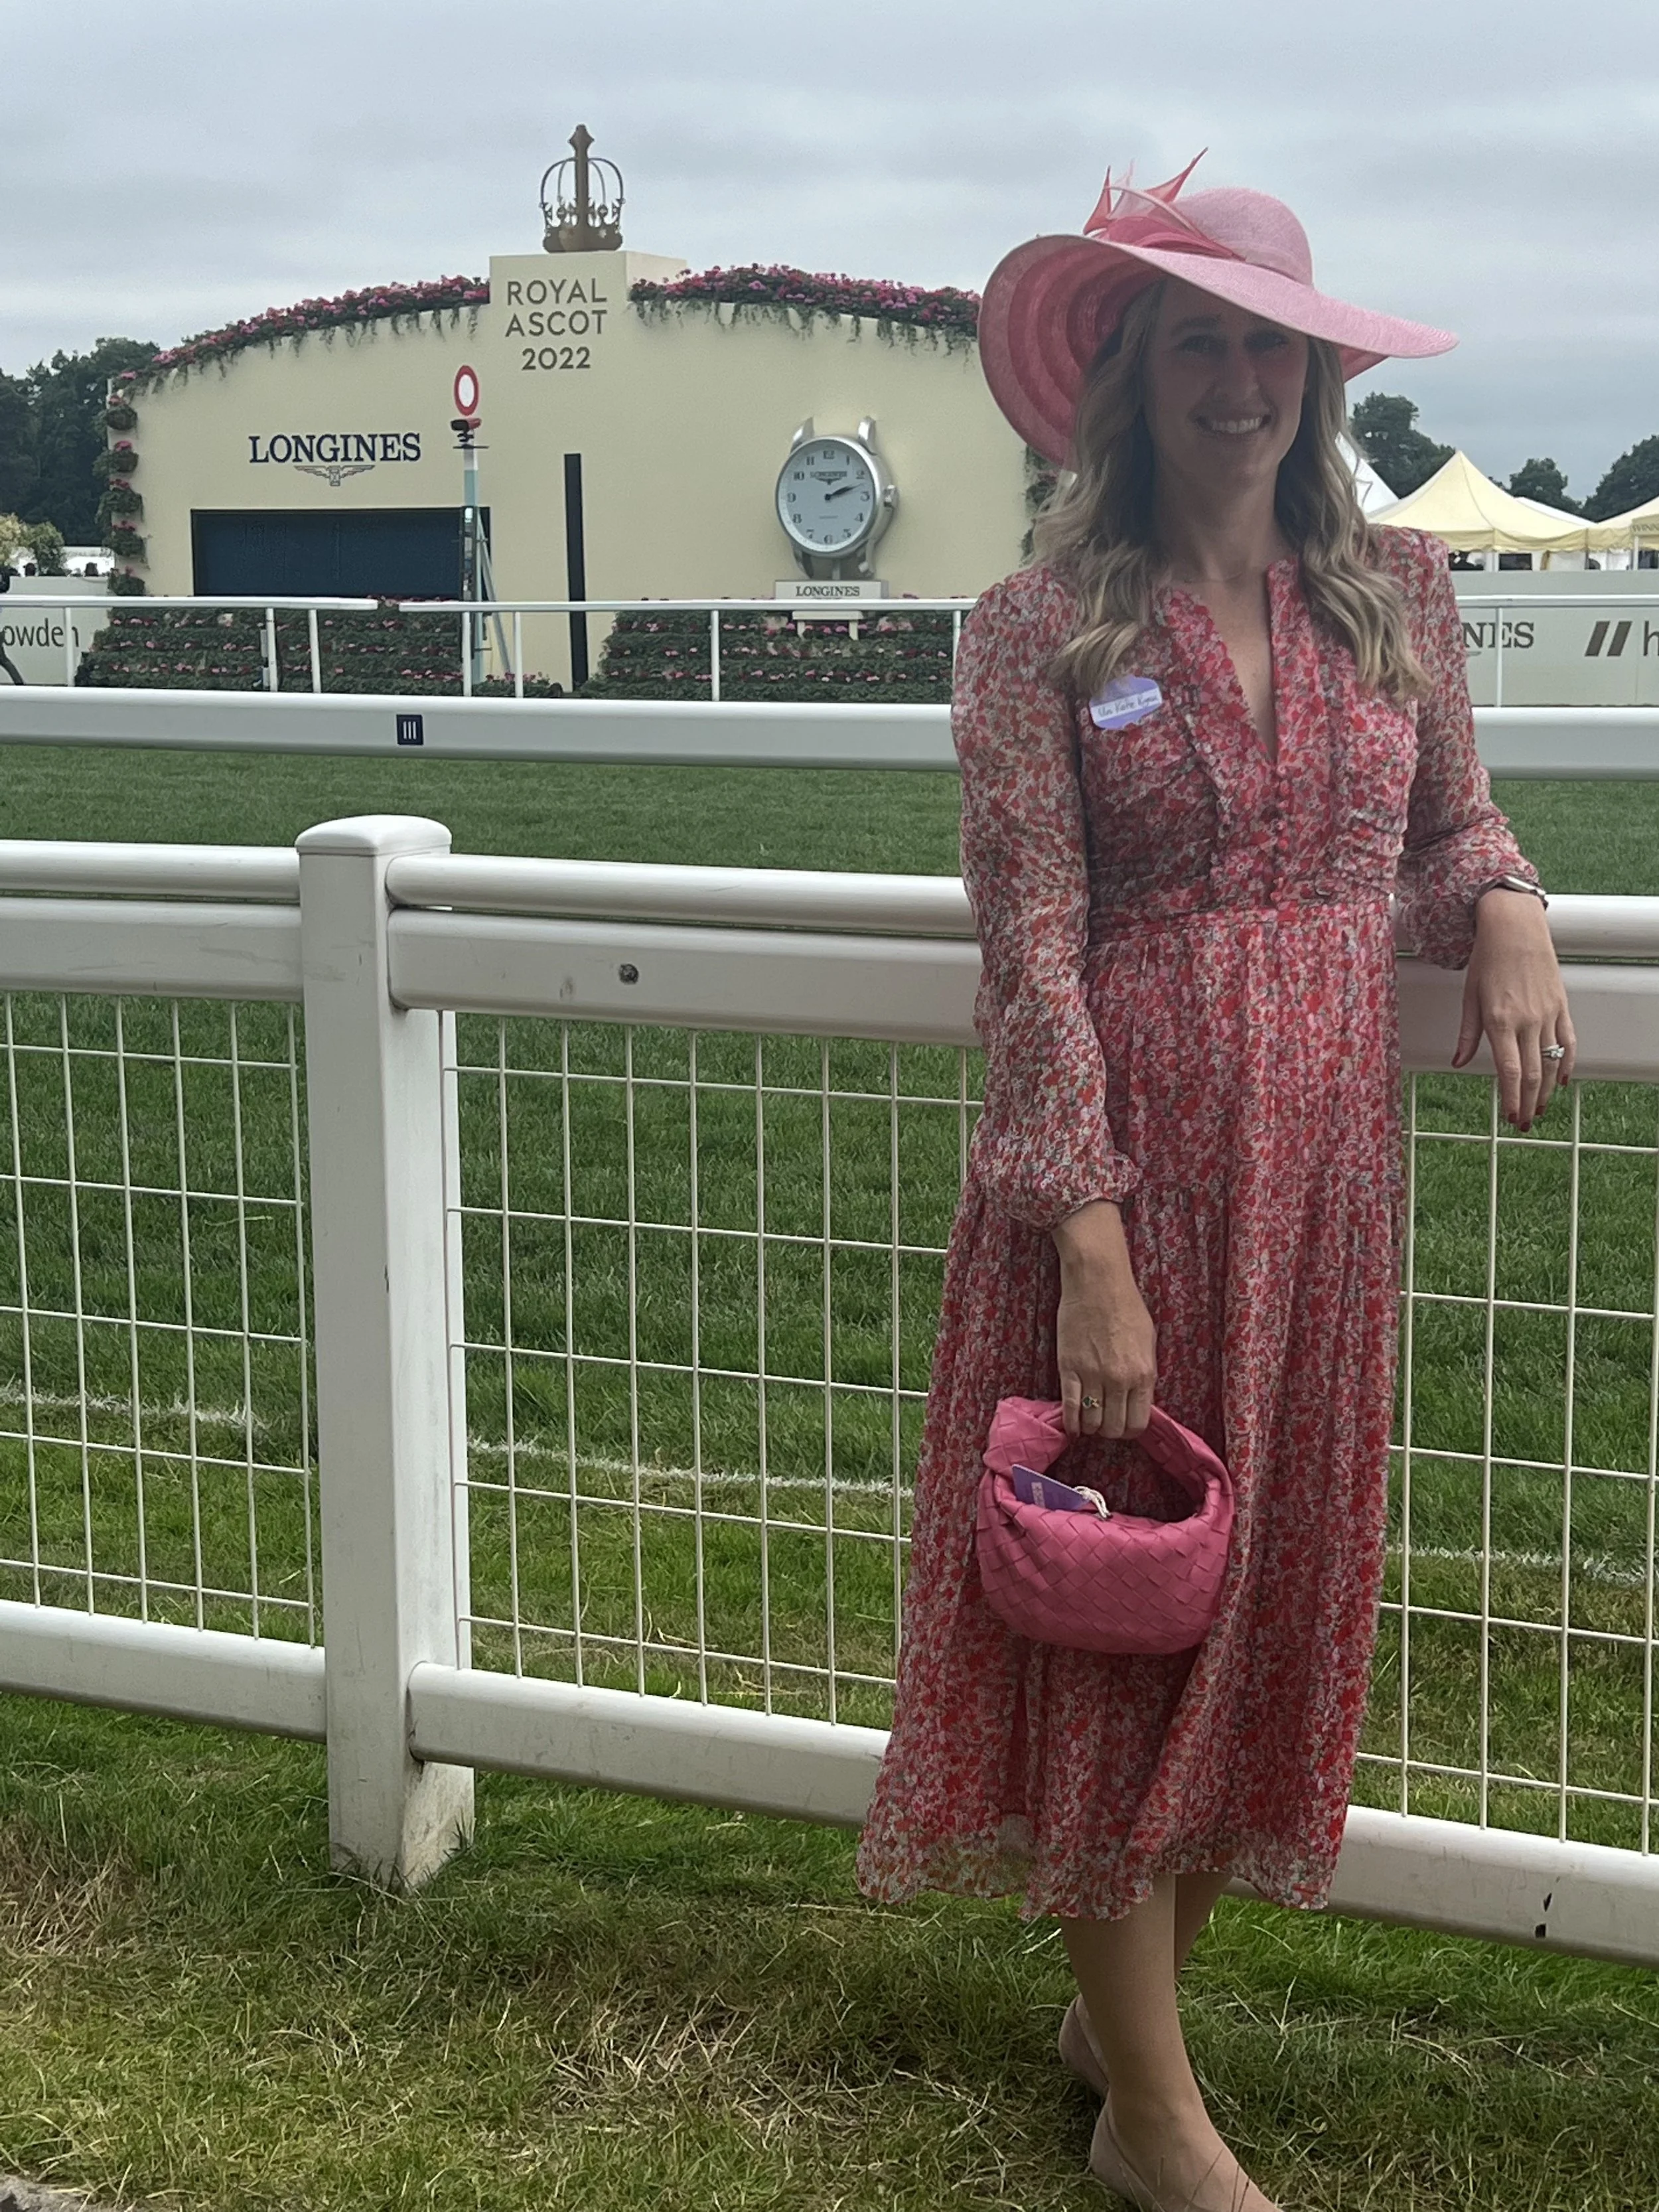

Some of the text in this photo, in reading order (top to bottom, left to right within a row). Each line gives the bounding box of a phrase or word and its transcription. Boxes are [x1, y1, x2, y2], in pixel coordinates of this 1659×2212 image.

[507, 278, 607, 305] ROYAL
[505, 310, 607, 337] ASCOT
[522, 346, 591, 370] 2022
[248, 433, 421, 463] LONGINES
[796, 585, 860, 597] LONGINES
